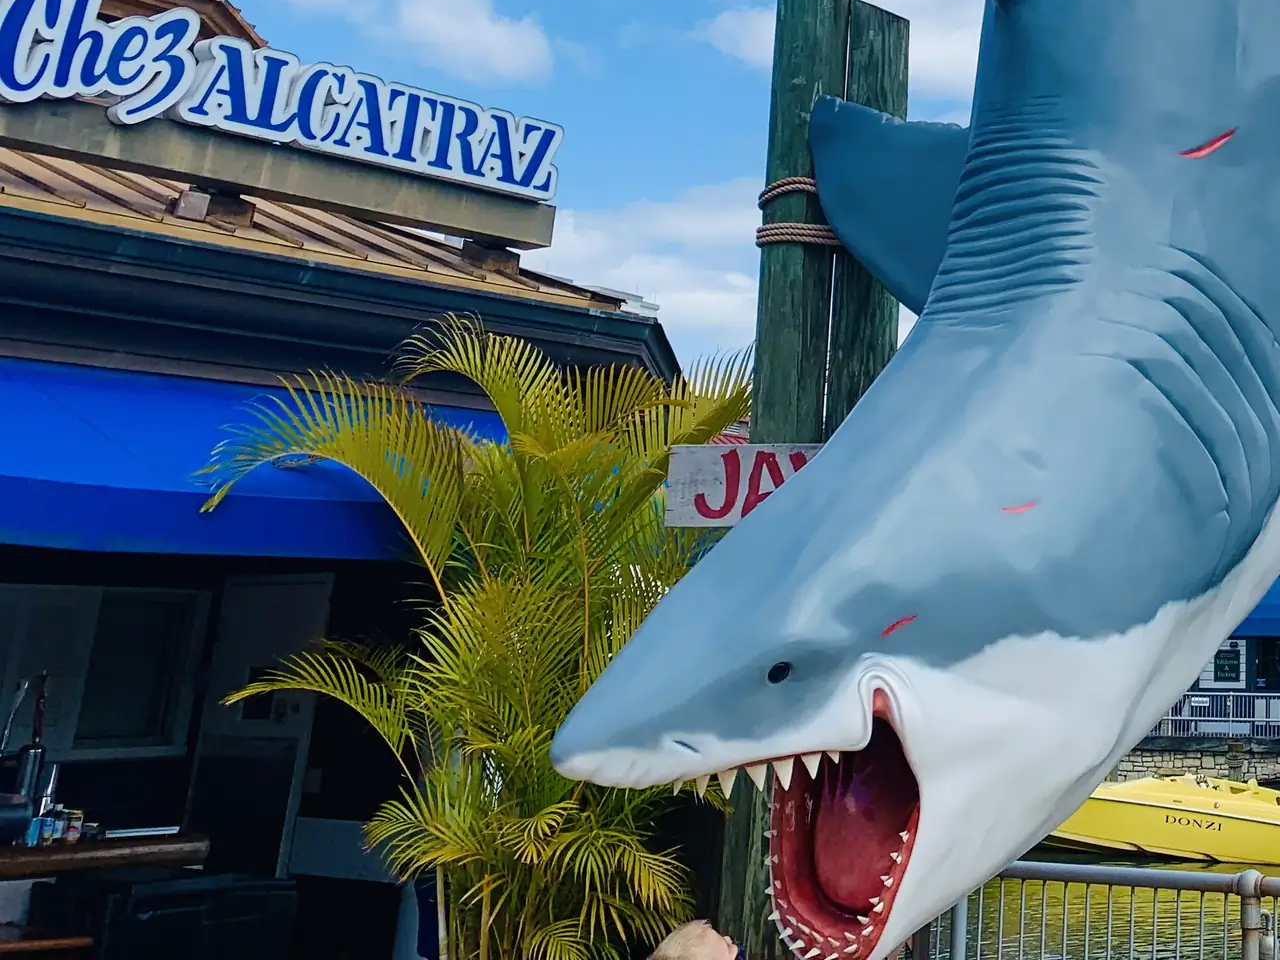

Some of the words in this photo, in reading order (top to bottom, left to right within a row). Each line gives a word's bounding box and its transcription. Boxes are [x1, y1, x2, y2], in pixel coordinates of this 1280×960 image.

[188, 43, 557, 192] ALCATRAZ
[693, 448, 809, 520] JA
[1165, 814, 1222, 831] DONZI
